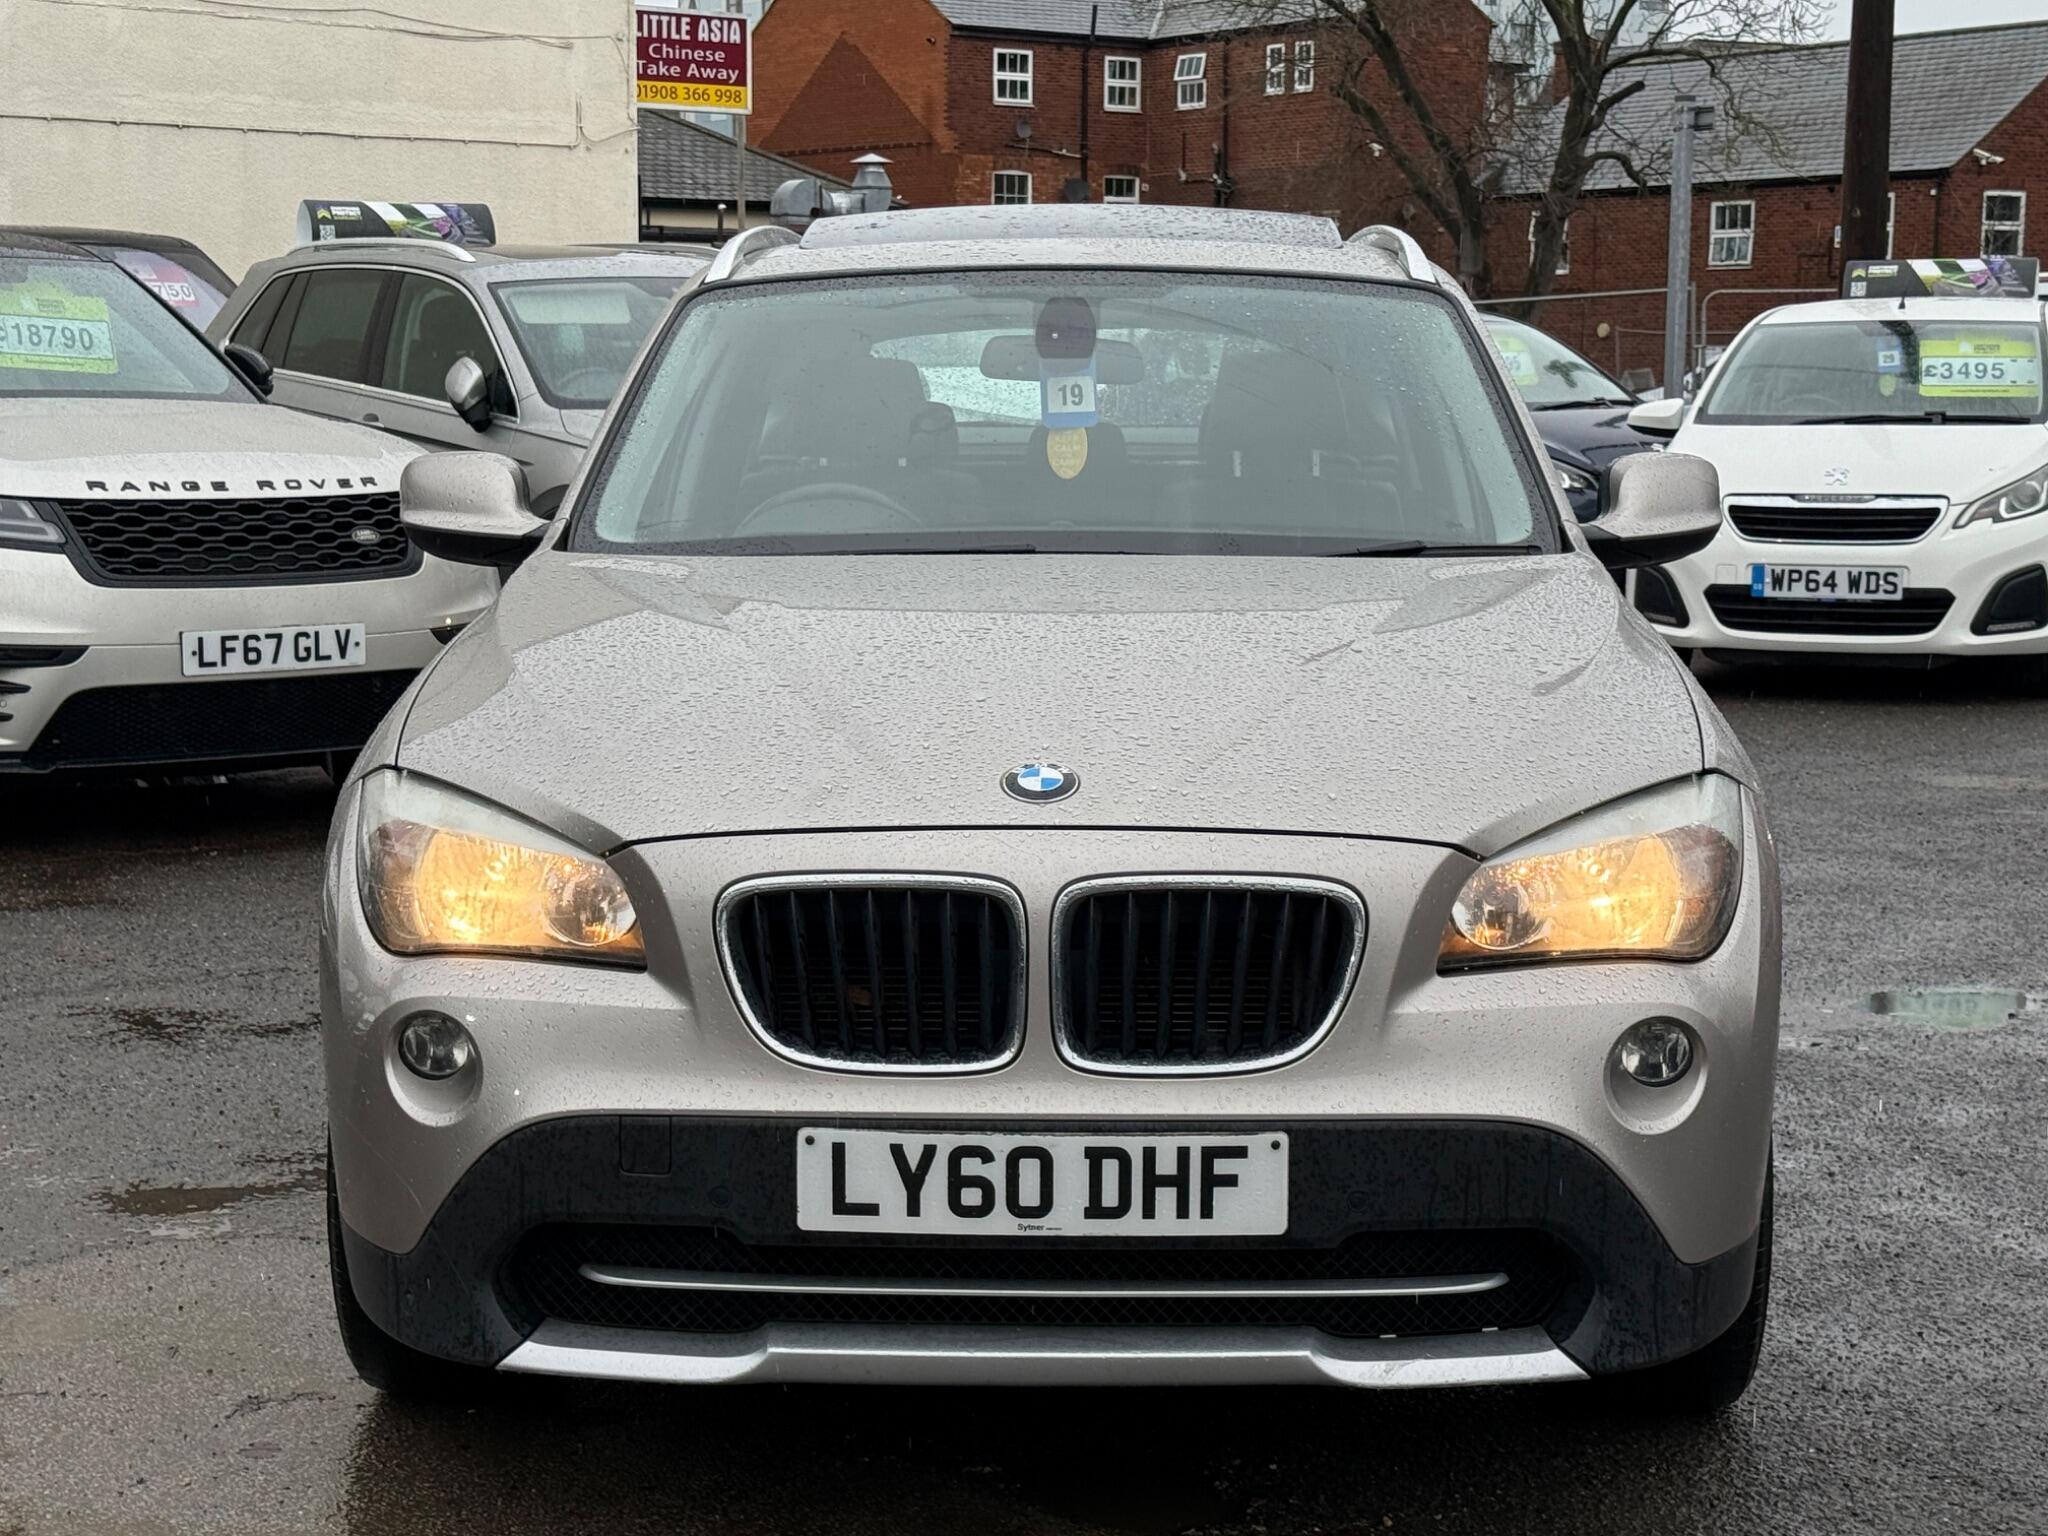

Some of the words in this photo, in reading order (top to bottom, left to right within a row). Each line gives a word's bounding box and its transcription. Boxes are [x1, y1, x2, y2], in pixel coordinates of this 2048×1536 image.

[697, 18, 741, 44] ASIA
[648, 43, 726, 62] Chinese
[637, 60, 681, 77] Take
[686, 63, 739, 84] Away
[682, 86, 711, 101] 366
[714, 89, 742, 103] 998
[1923, 362, 2005, 380] £3495
[1057, 383, 1084, 406] 19
[86, 480, 229, 492] RANGE
[256, 477, 378, 491] ROVER
[1771, 569, 1838, 593] WP64
[1848, 571, 1899, 594] WDS
[198, 632, 283, 668] LF67
[294, 629, 351, 663] GLV
[831, 1142, 1054, 1219] LY60
[1084, 1146, 1248, 1220] DHF
